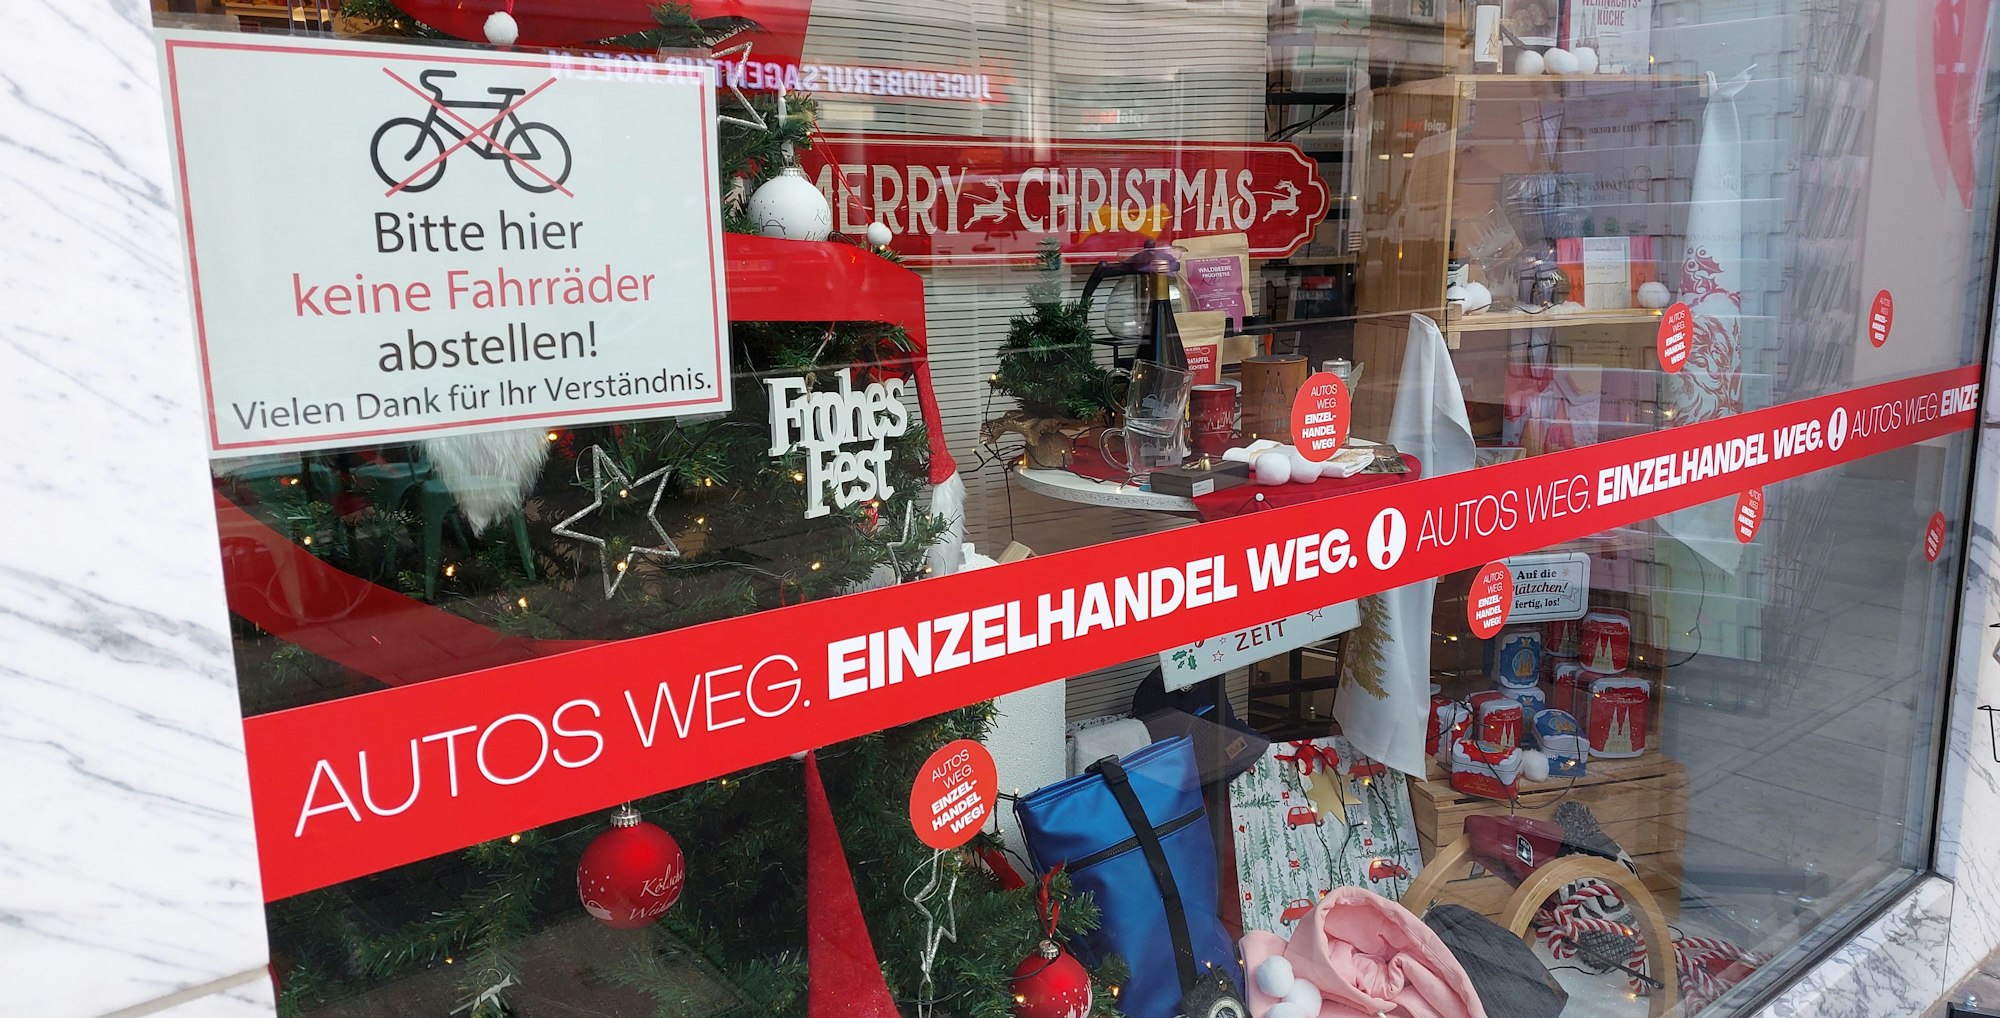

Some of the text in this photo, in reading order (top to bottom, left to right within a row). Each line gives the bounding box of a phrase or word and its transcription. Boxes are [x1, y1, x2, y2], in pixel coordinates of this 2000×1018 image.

[1597, 8, 1625, 26] KÜCHE
[1016, 167, 1257, 233] CHRISTMAS
[374, 209, 583, 253] Bitte hier
[293, 264, 655, 316] keine Fahrräder
[1668, 309, 1686, 324] AUTOS
[378, 321, 598, 372] abstellen!
[232, 367, 713, 430] Vielen Dank für Ihr Verständnis.
[1311, 384, 1338, 397] AUTOS
[763, 368, 907, 457] Frohes
[1305, 411, 1337, 425] EINZEL-
[1302, 425, 1336, 439] HANDEL
[1312, 437, 1336, 451] WEG!
[804, 435, 895, 519] Fest
[1483, 571, 1504, 584] AUTOS
[1517, 569, 1557, 580] Auf die
[294, 698, 604, 838] AUTOS
[624, 654, 811, 749] WEG.
[827, 555, 1238, 701] EINZELHANDEL
[1246, 528, 1357, 593] WEG.
[1416, 490, 1518, 552] AUTOS
[1526, 475, 1591, 524] WEG.
[1597, 433, 1768, 506] EINZELHANDEL
[1773, 419, 1823, 460] WEG.
[1850, 400, 1902, 440] AUTOS
[1905, 392, 1938, 426] WEG.
[1941, 383, 1980, 417] EINZE
[1476, 605, 1502, 620] HANDEL
[1478, 594, 1503, 608] EINZEL-
[1515, 598, 1560, 609] fertig, los!
[1234, 618, 1287, 652] ZEIT
[1483, 616, 1502, 629] WEG!
[932, 749, 969, 783] AUTOS
[943, 764, 974, 789] WEG.
[931, 780, 977, 815] EINZEL-
[931, 792, 981, 831] HANDEL
[950, 804, 985, 834] WEG!
